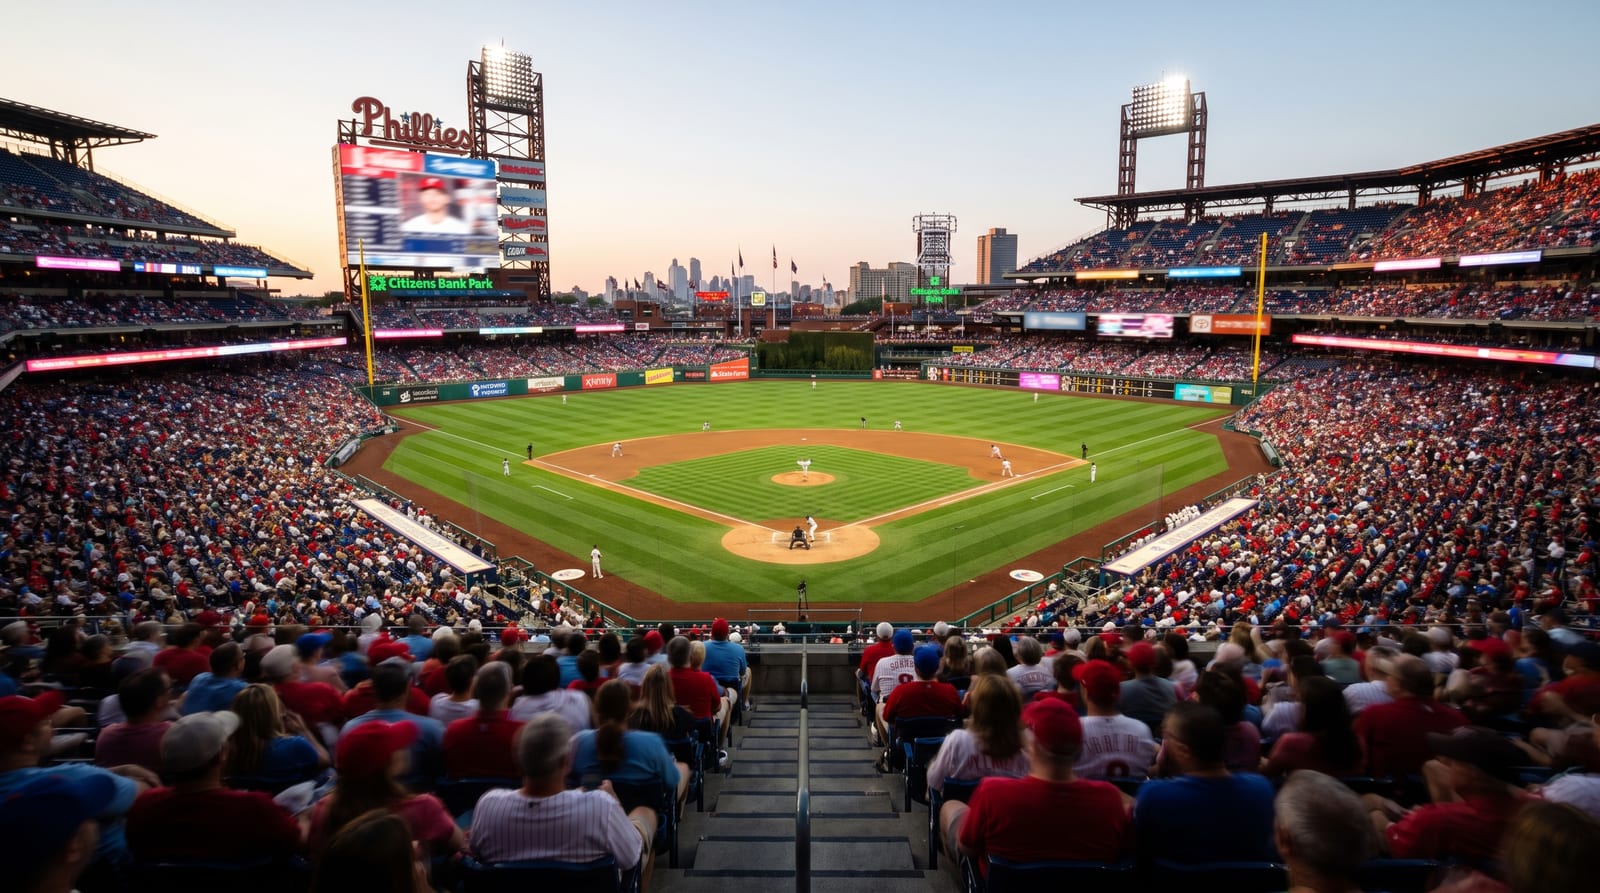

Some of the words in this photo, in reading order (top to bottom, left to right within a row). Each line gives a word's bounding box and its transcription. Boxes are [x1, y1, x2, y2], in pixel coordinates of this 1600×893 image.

[352, 96, 474, 150] Phillies
[388, 277, 437, 289] Citizens
[438, 278, 467, 289] Bank
[468, 277, 494, 289] Park
[910, 288, 940, 296] Citizens
[940, 287, 960, 296] Bank
